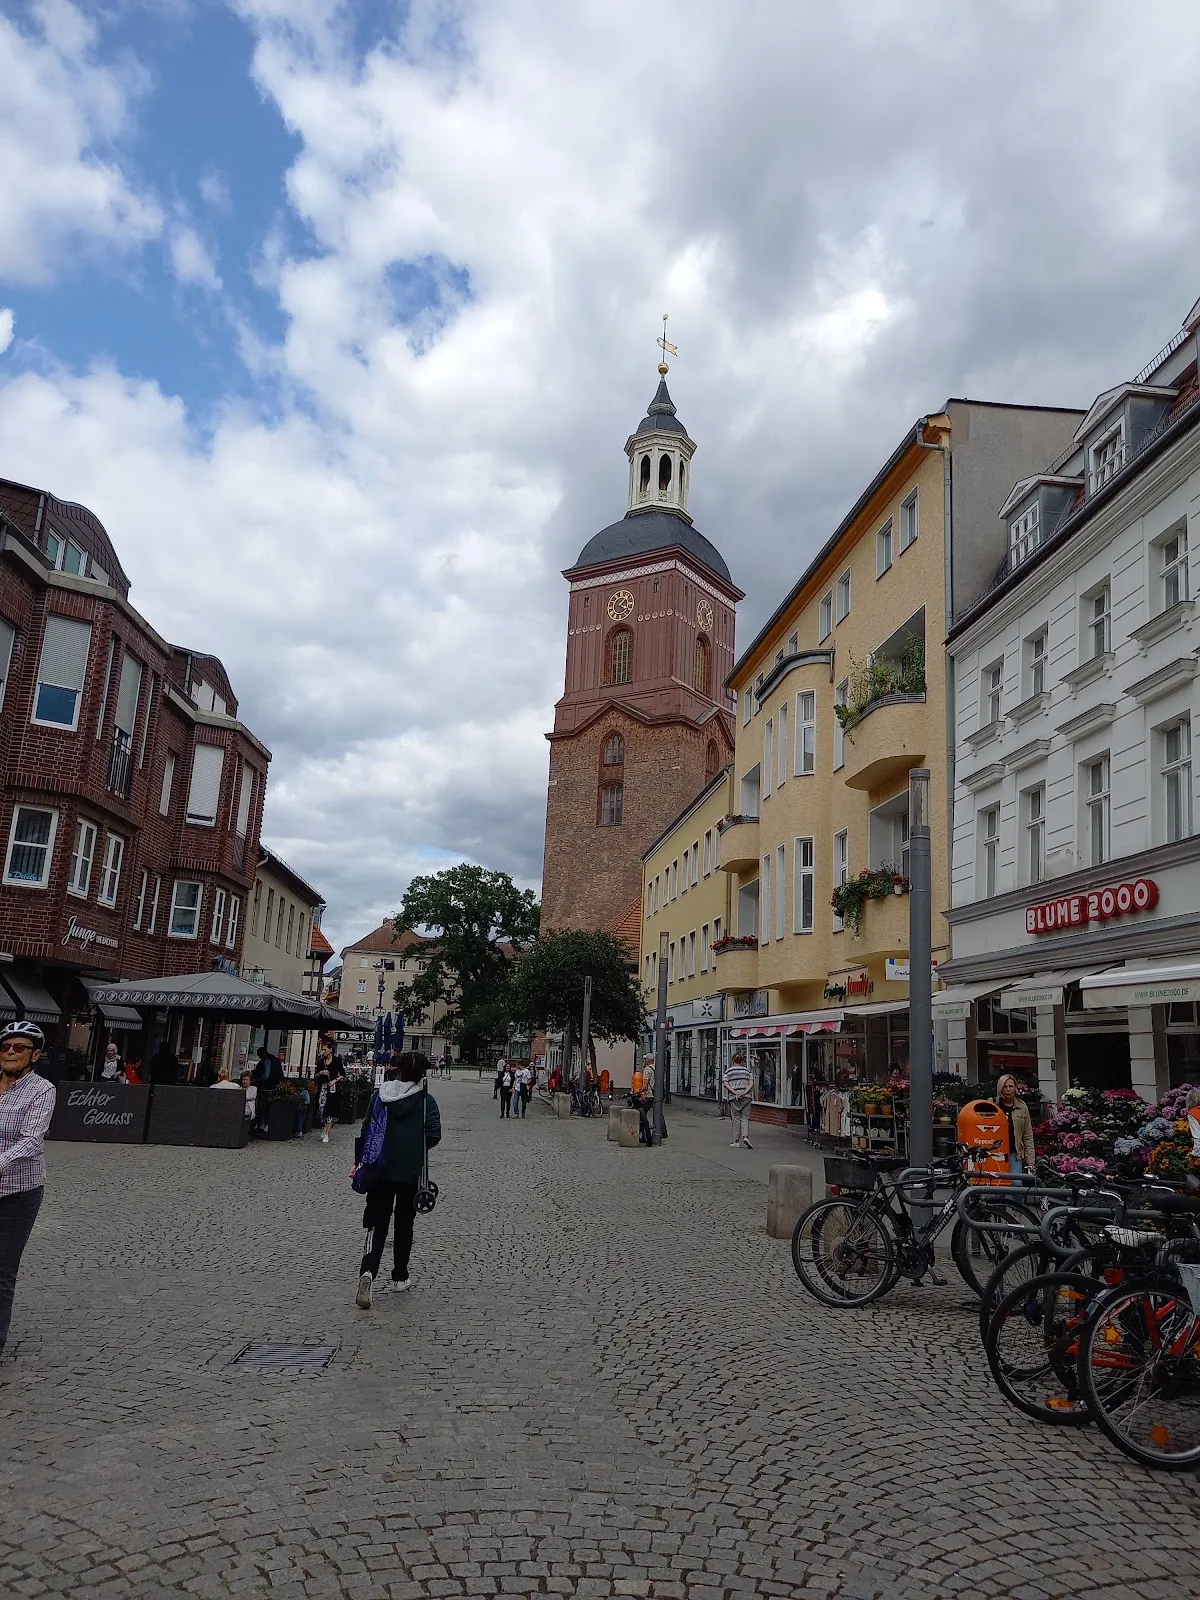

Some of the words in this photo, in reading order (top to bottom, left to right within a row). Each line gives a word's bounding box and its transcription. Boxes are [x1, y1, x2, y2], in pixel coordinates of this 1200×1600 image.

[1026, 898, 1081, 932] BLUME
[1088, 881, 1150, 919] 2000
[61, 915, 97, 950] Junge
[847, 973, 869, 997] family
[67, 1087, 116, 1106] Echter
[83, 1108, 134, 1126] Genuss
